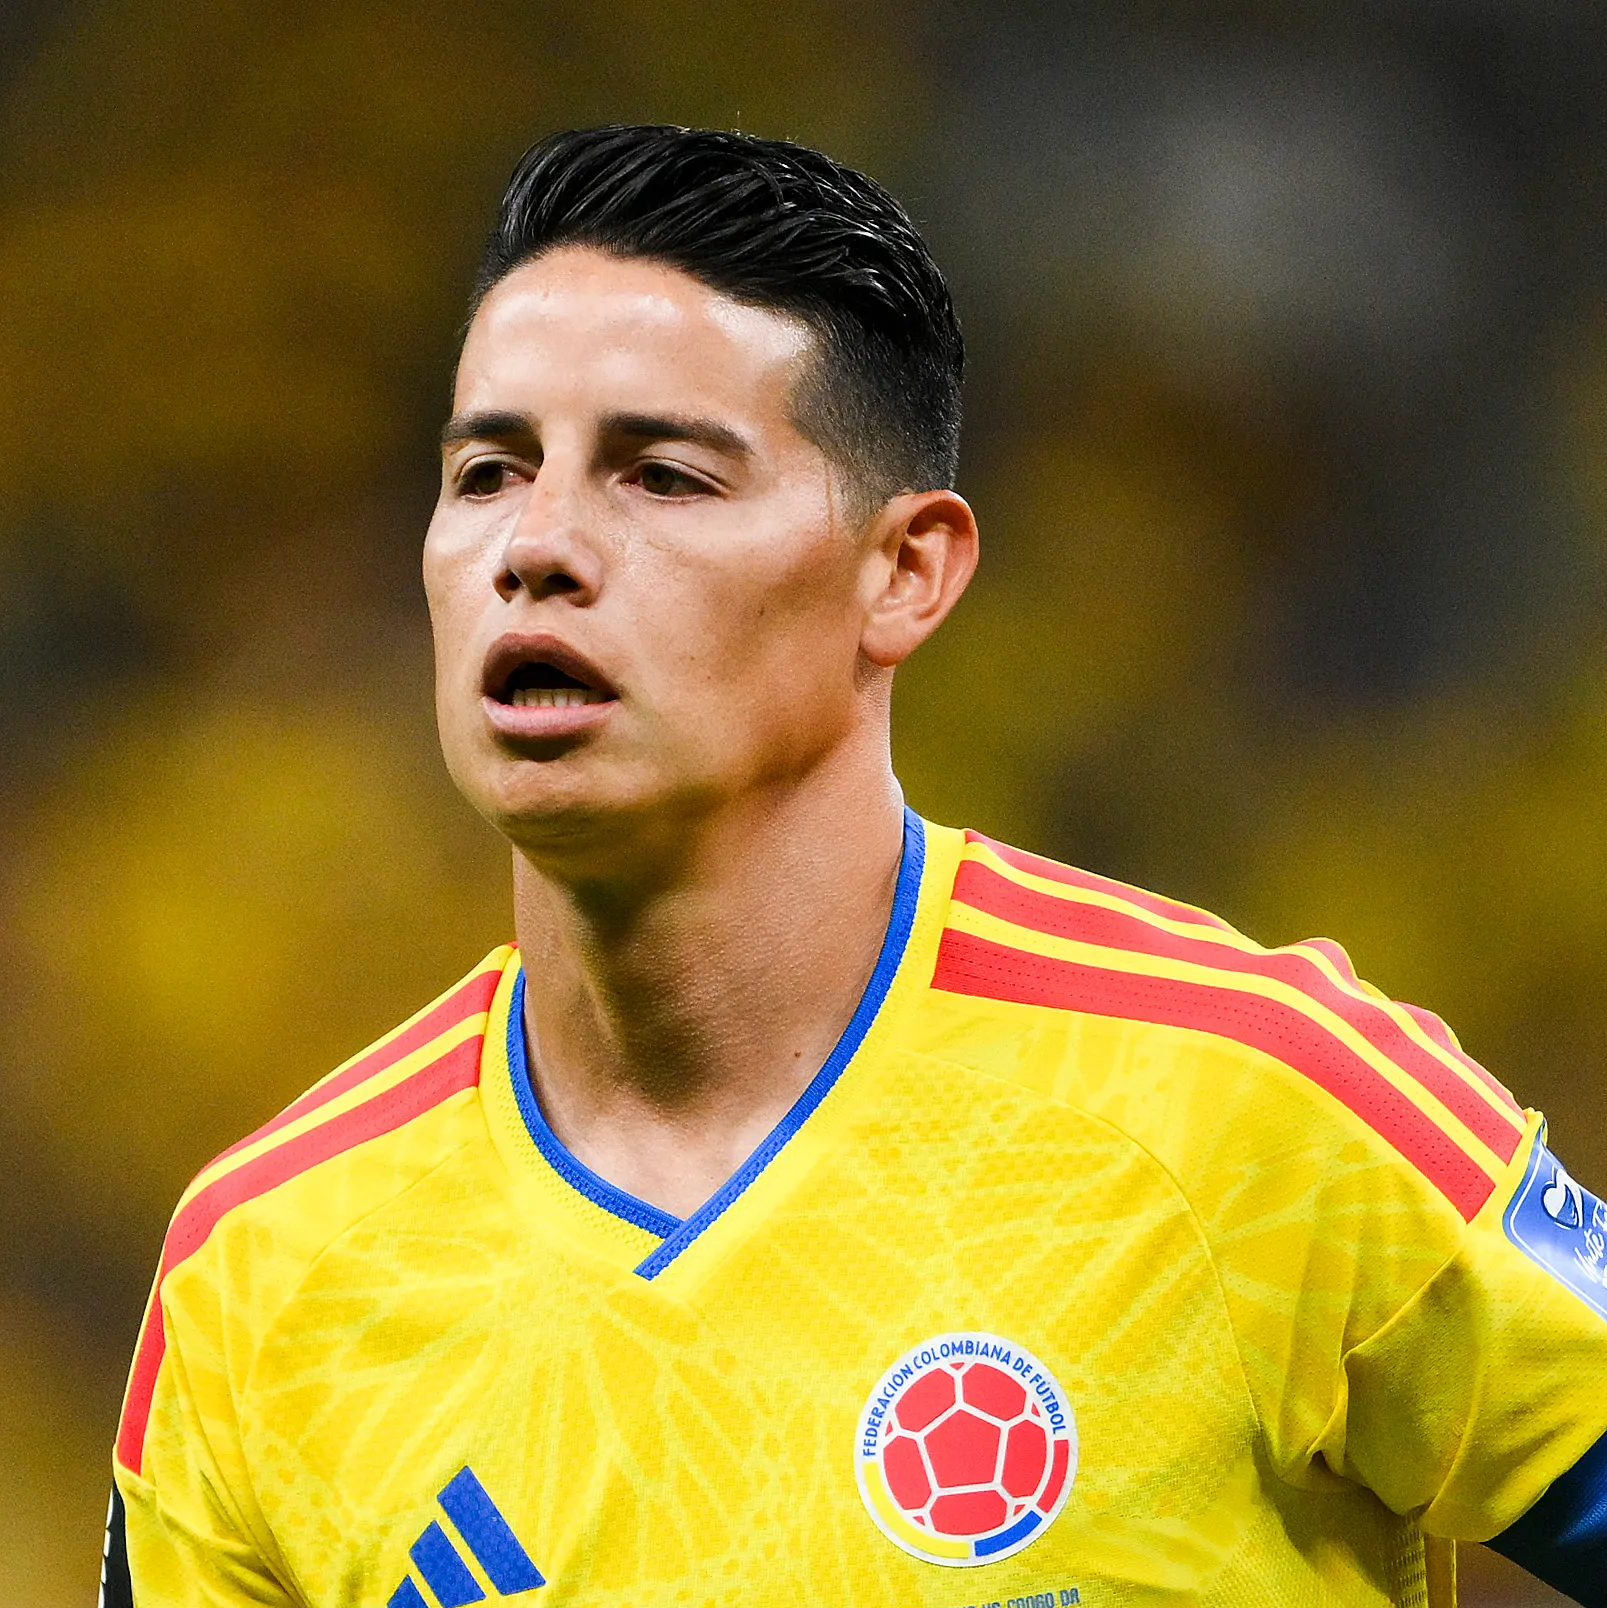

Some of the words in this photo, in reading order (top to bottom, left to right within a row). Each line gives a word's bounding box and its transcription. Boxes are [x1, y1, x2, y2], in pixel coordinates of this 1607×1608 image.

[913, 1340, 1011, 1369] COLOMBIANA
[1012, 1357, 1033, 1378] DE
[1059, 1587, 1081, 1607] DR
